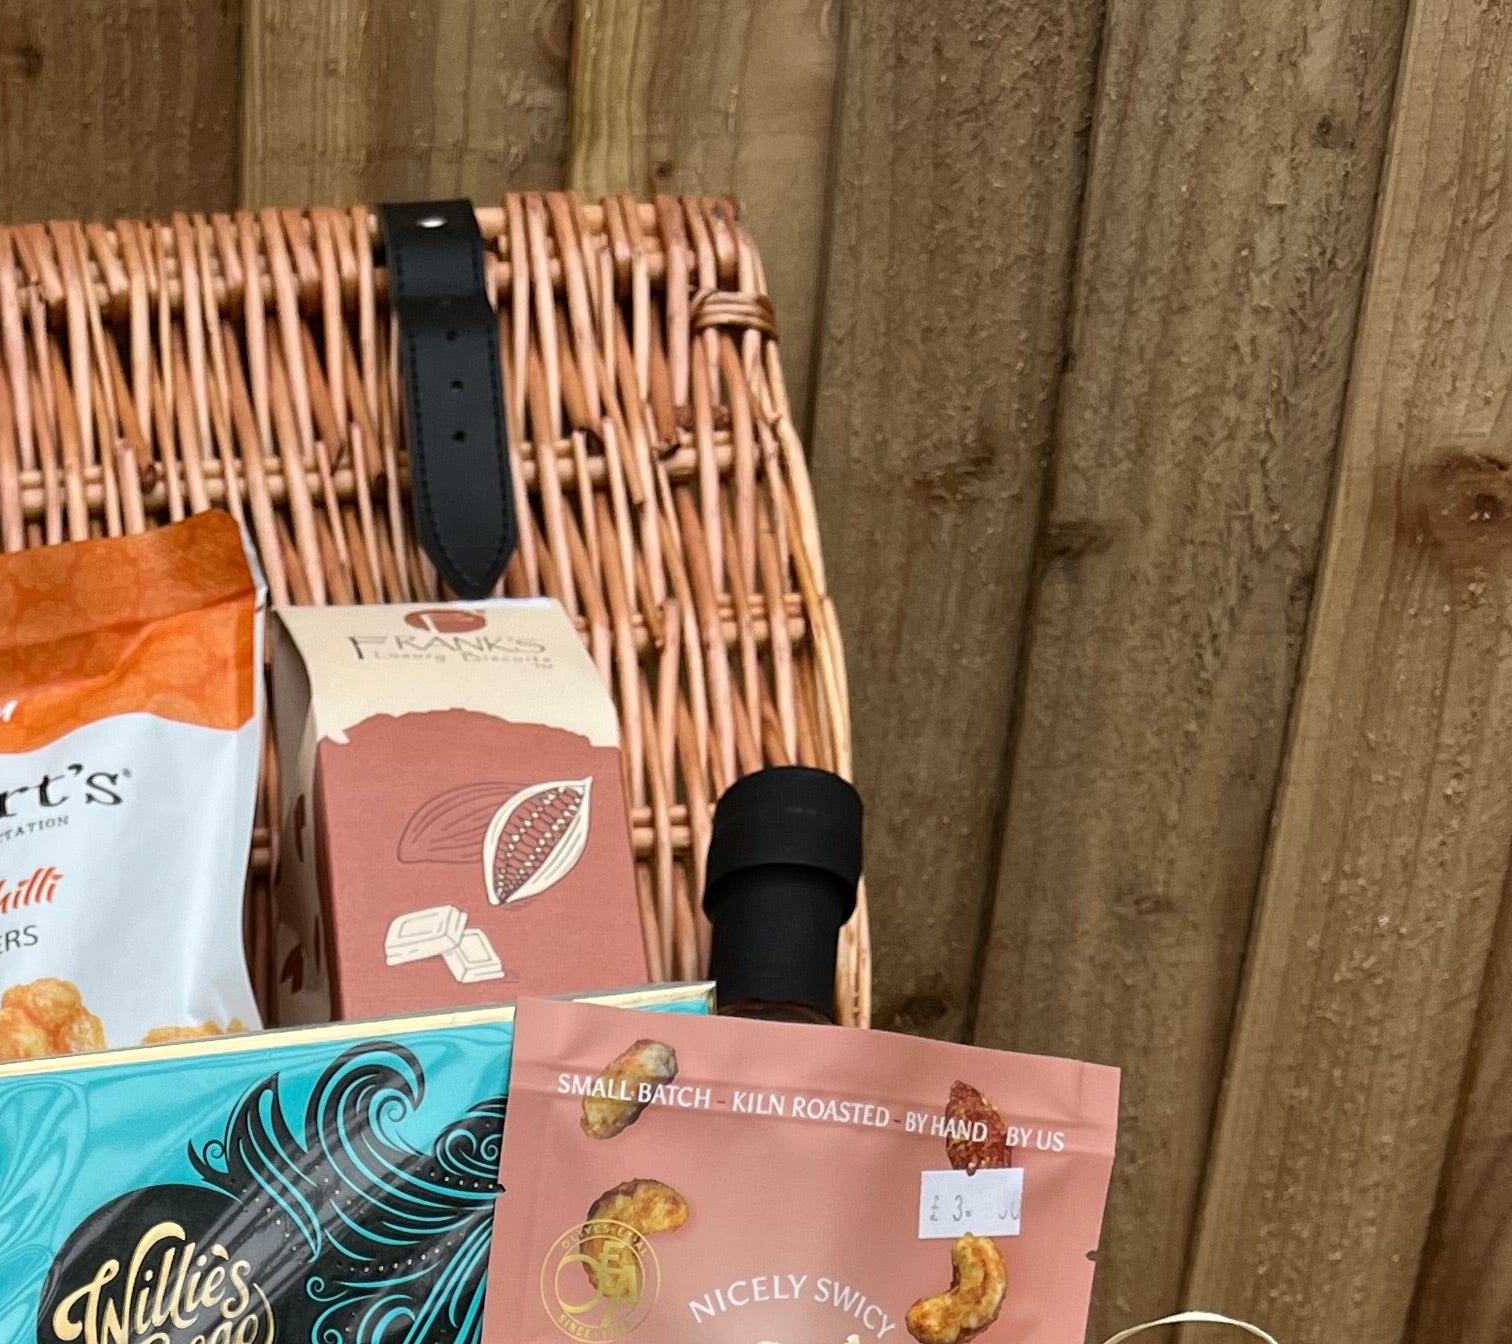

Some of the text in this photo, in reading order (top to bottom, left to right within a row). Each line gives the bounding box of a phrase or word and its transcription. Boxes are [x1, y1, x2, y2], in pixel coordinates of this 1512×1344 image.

[557, 1072, 1065, 1153] SMALL BATCH KILN ROASTED BY HAND BY US
[688, 1274, 896, 1340] NICELY SWICY
